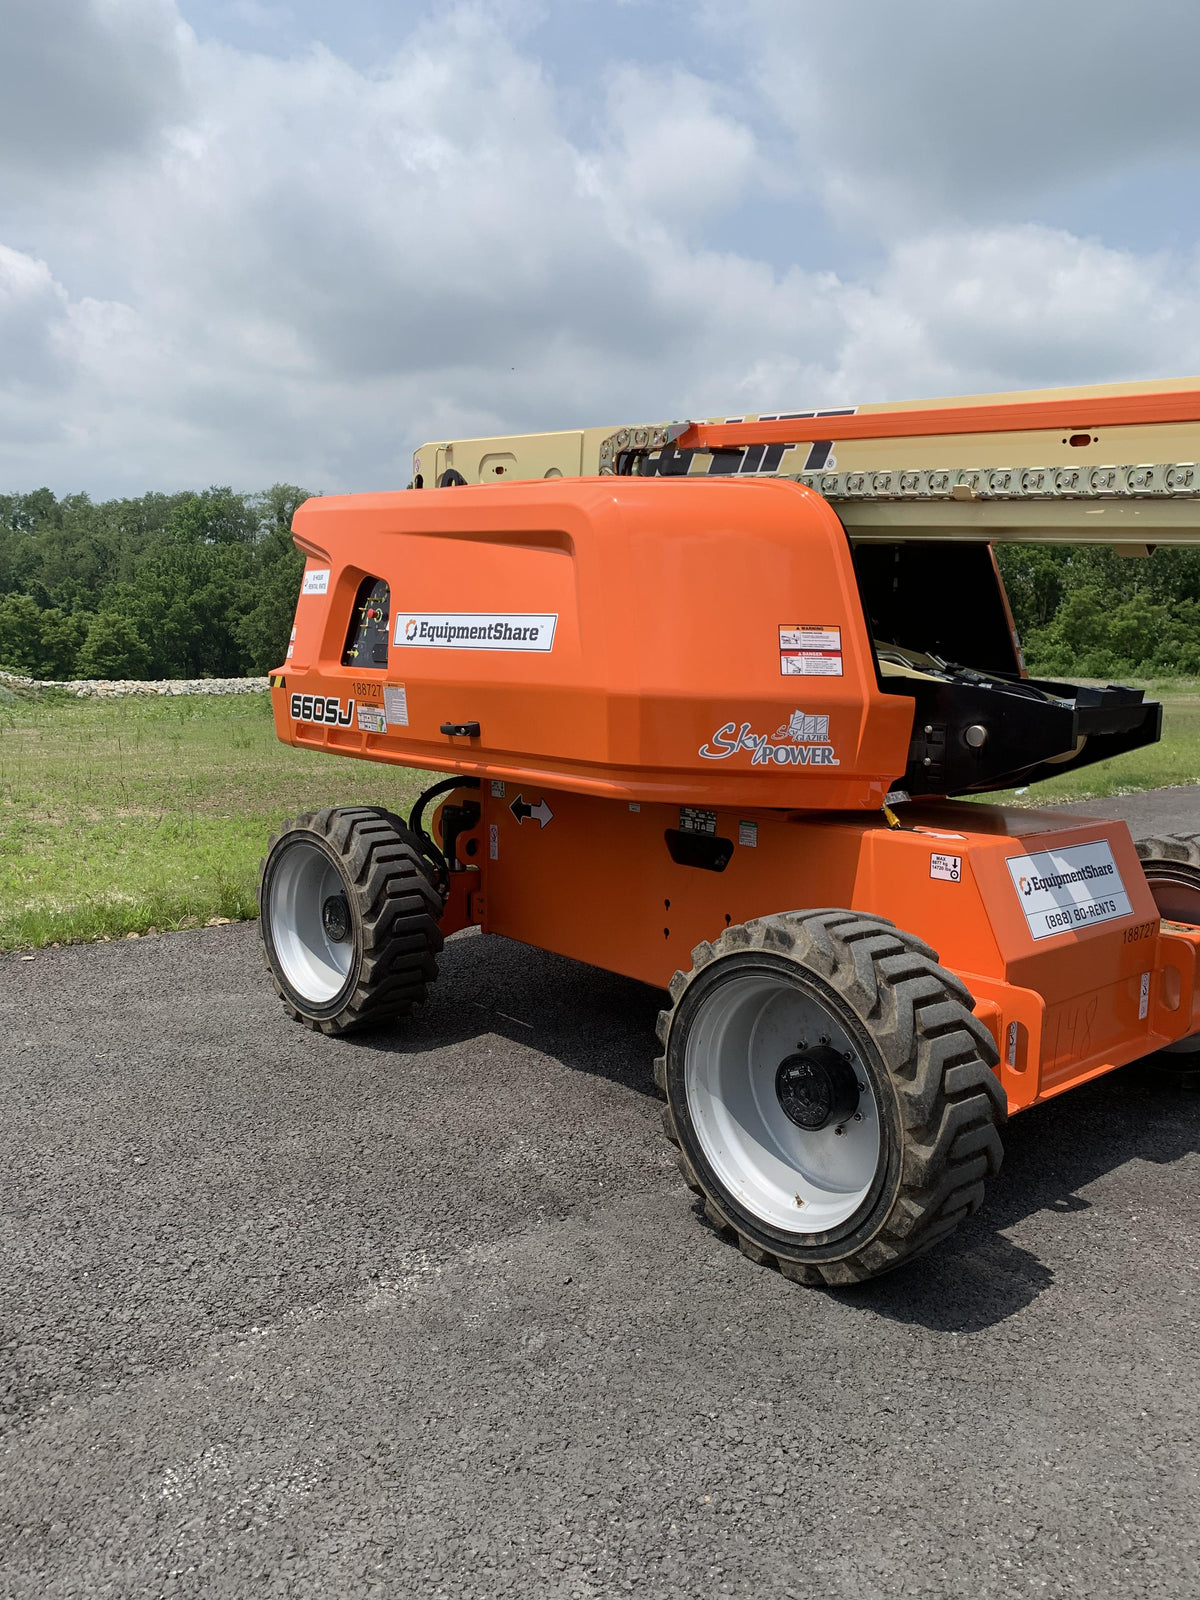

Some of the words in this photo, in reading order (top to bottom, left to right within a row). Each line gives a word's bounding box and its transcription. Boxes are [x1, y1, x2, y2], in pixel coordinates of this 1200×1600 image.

[419, 621, 539, 642] EquipmentShare
[353, 682, 381, 697] 188727
[291, 693, 355, 727] 660SJ
[699, 722, 767, 765] Sky
[759, 746, 835, 765] POWER
[796, 734, 829, 742] GLAZIER
[1030, 864, 1114, 892] EquipmentShare
[1045, 910, 1074, 930] (888)
[1073, 900, 1117, 921] 80-RENTS
[1124, 922, 1155, 944] 188727
